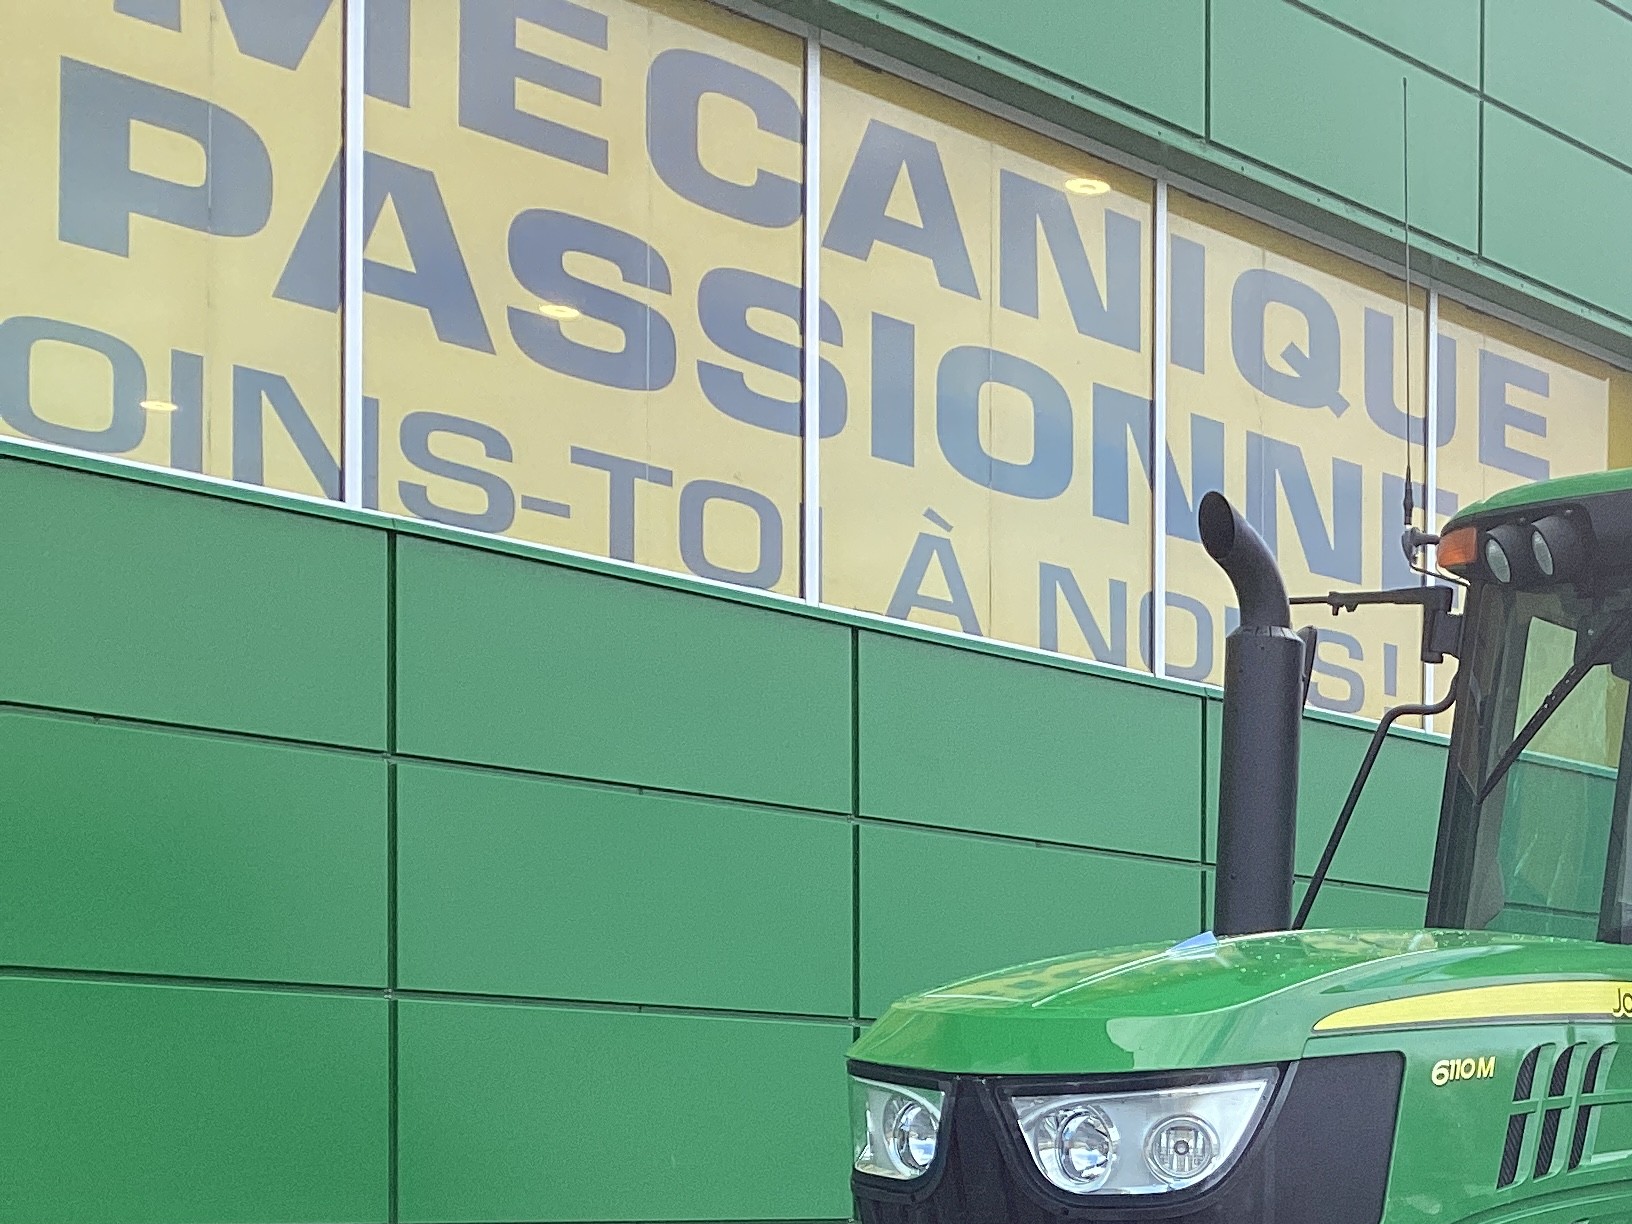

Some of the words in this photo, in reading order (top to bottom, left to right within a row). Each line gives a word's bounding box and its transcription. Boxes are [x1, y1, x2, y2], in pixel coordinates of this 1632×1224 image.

[884, 507, 983, 637] À
[1039, 561, 1397, 722] NOS!
[1431, 1056, 1496, 1086] 6110M
